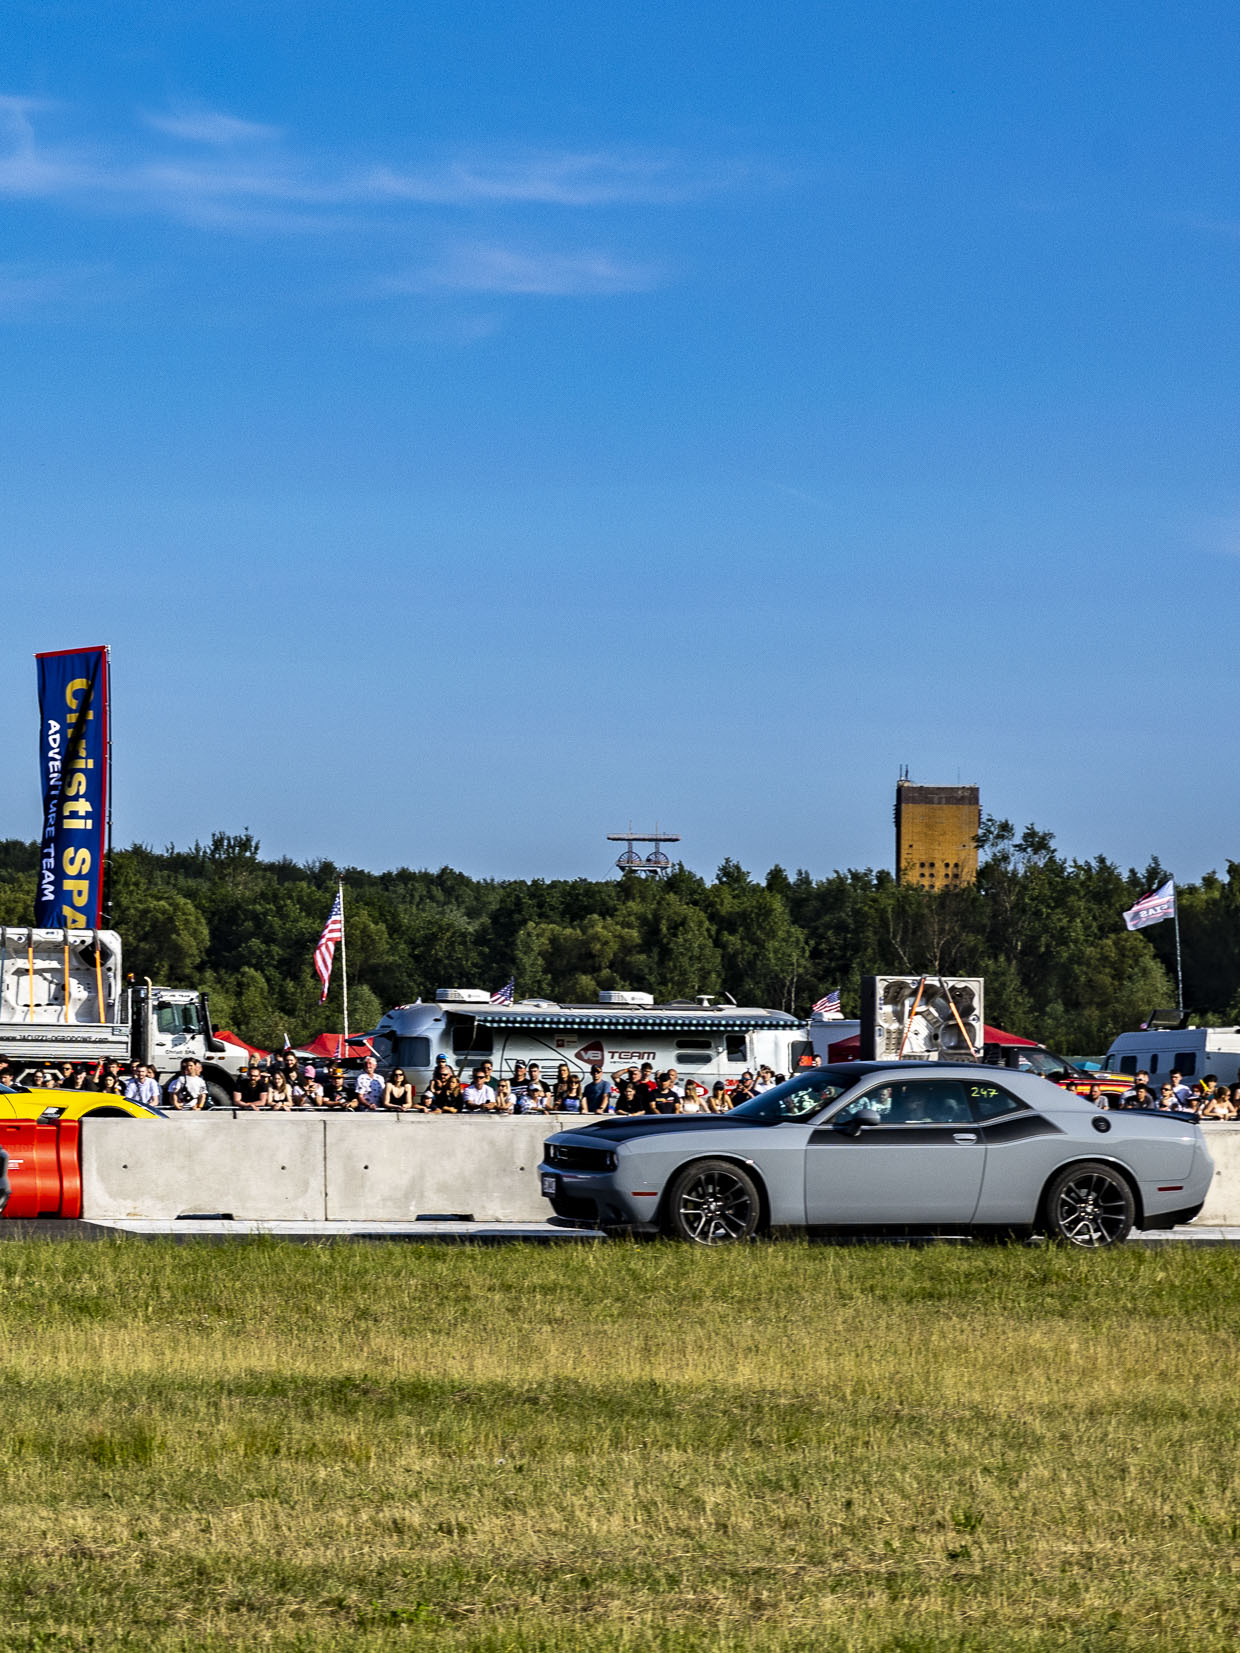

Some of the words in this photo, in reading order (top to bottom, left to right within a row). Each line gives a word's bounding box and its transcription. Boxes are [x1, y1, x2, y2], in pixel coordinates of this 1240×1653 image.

[45, 719, 62, 839] ADVENTURE
[63, 678, 94, 829] Christi
[41, 843, 55, 901] TEAM
[62, 847, 91, 929] SPA
[608, 1051, 656, 1060] TEAM
[970, 1086, 999, 1098] 247
